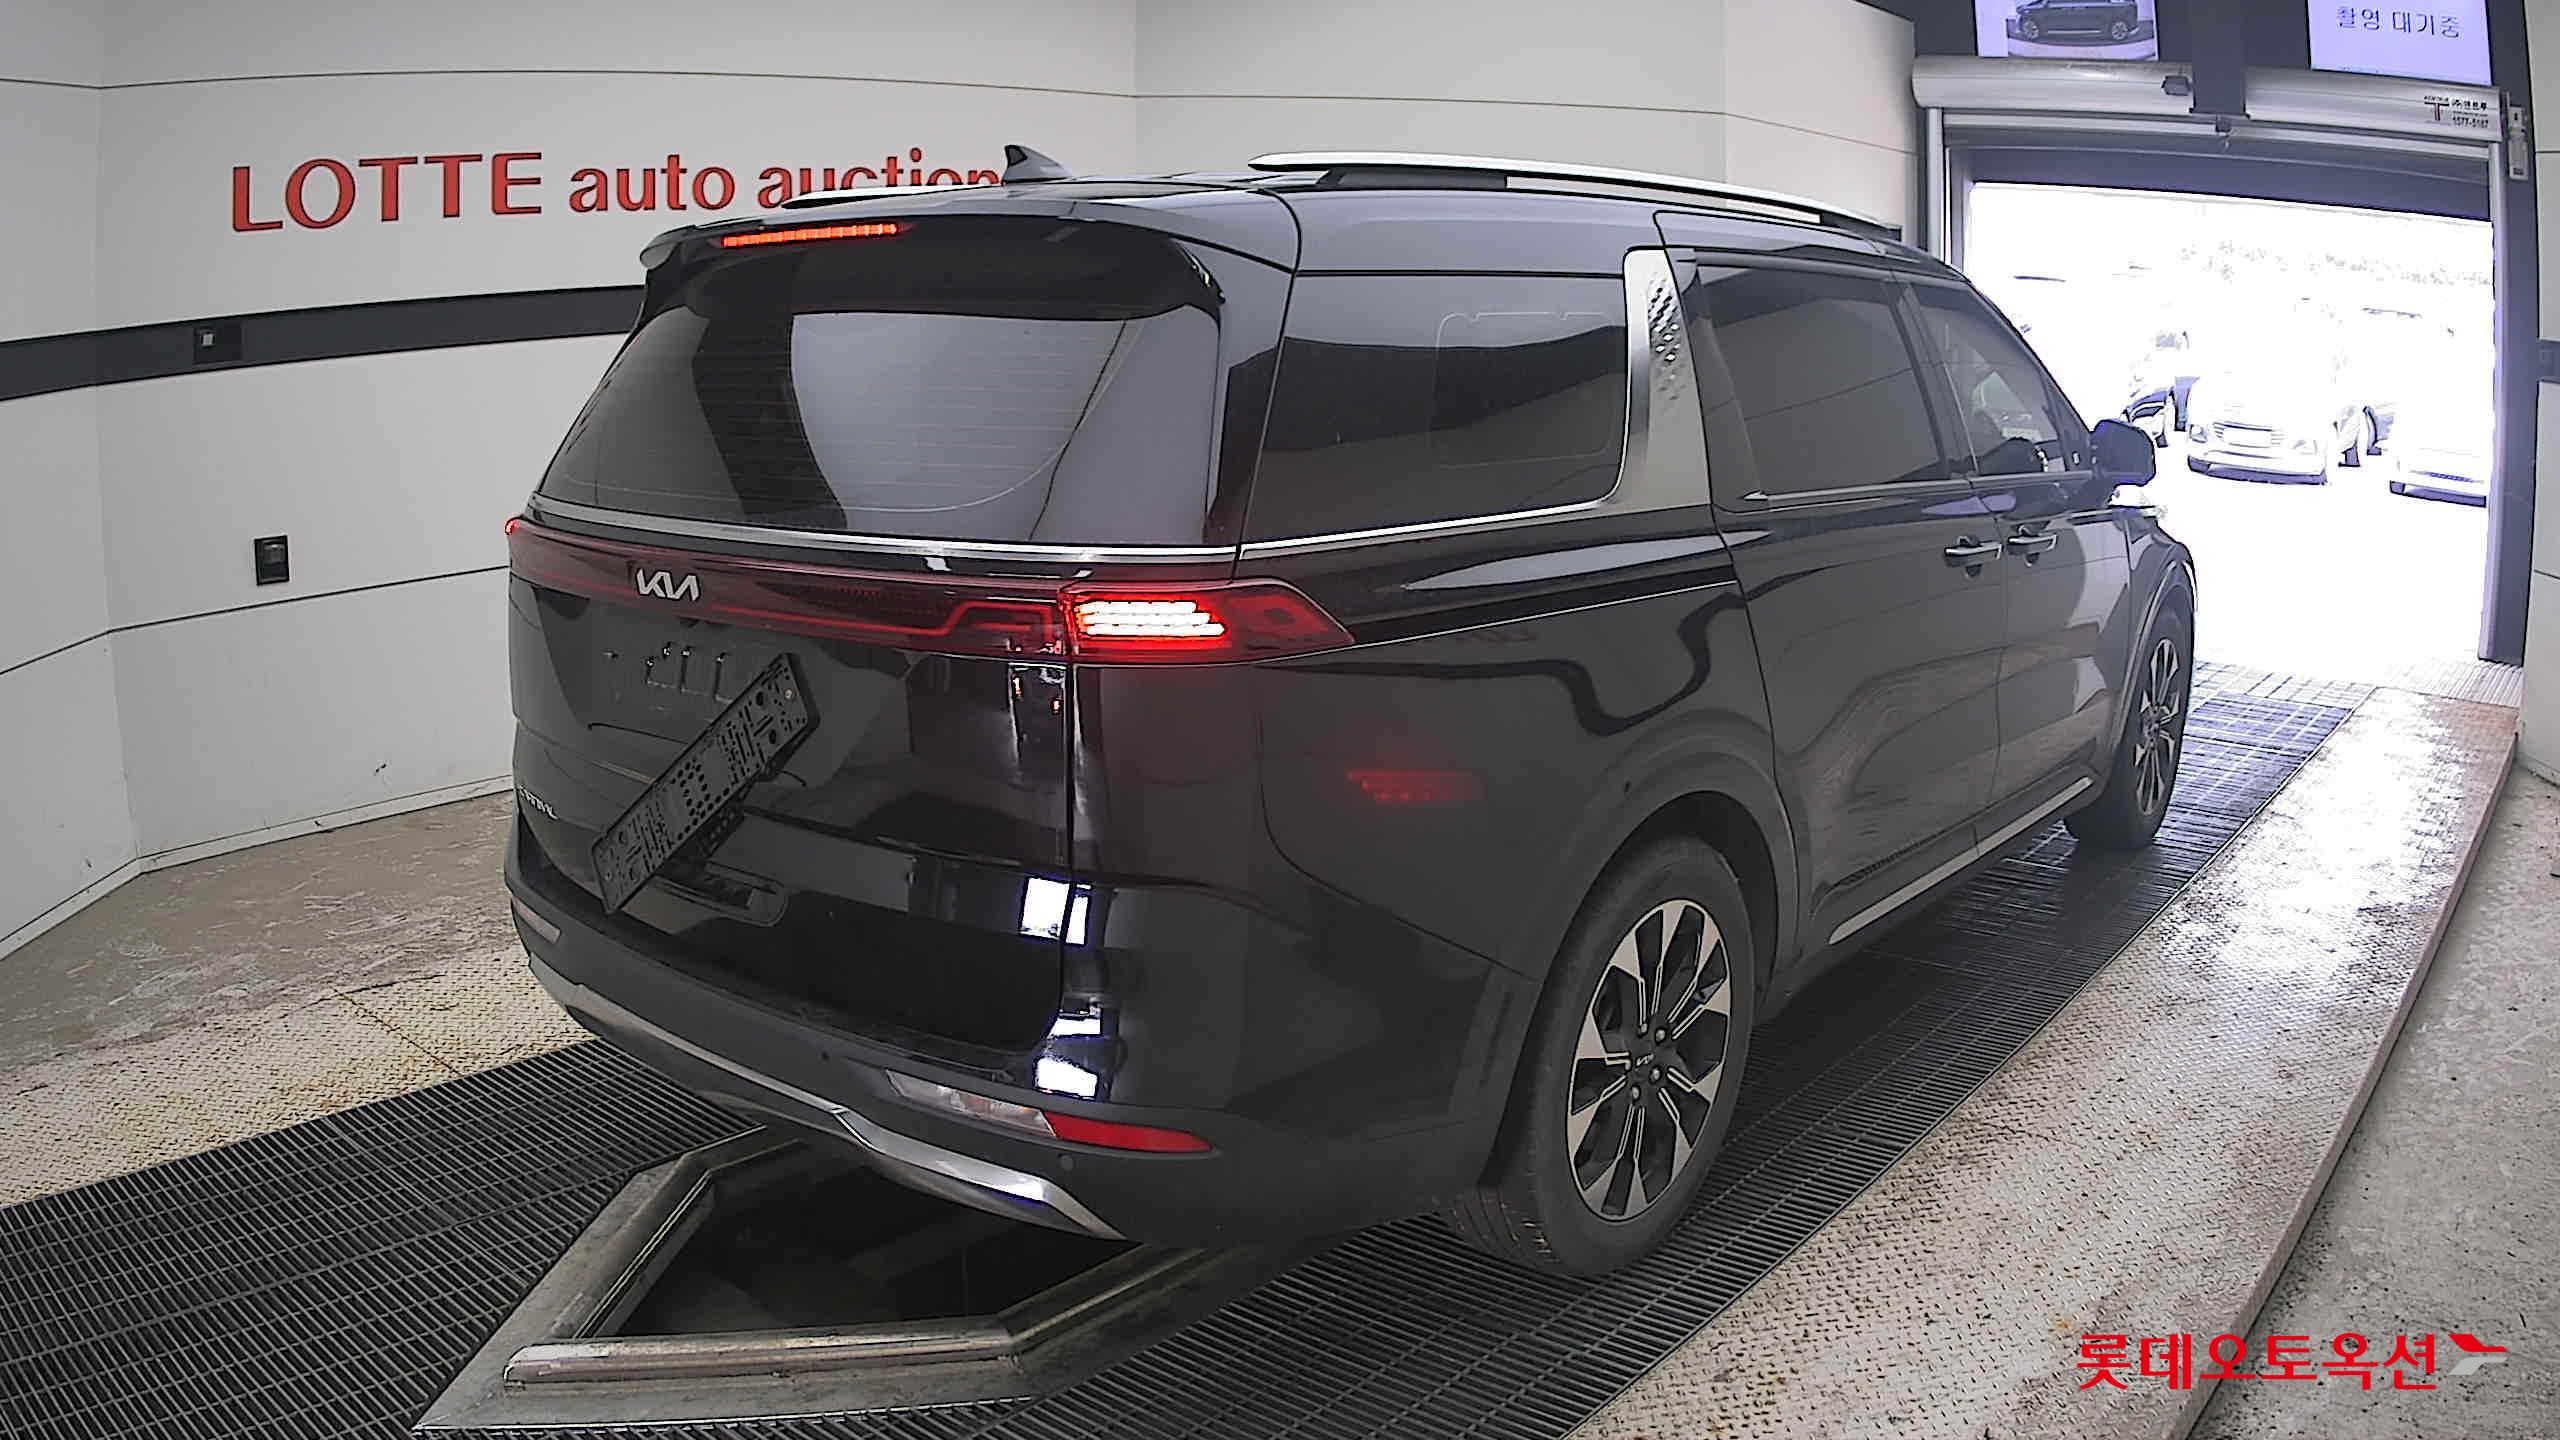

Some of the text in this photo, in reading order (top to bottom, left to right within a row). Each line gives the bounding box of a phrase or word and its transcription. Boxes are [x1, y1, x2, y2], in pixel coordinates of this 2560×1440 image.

[2338, 6, 2461, 38] 촬영 대기중
[232, 152, 542, 232] LOTTE
[568, 153, 736, 212] auto
[636, 569, 700, 601] KIA
